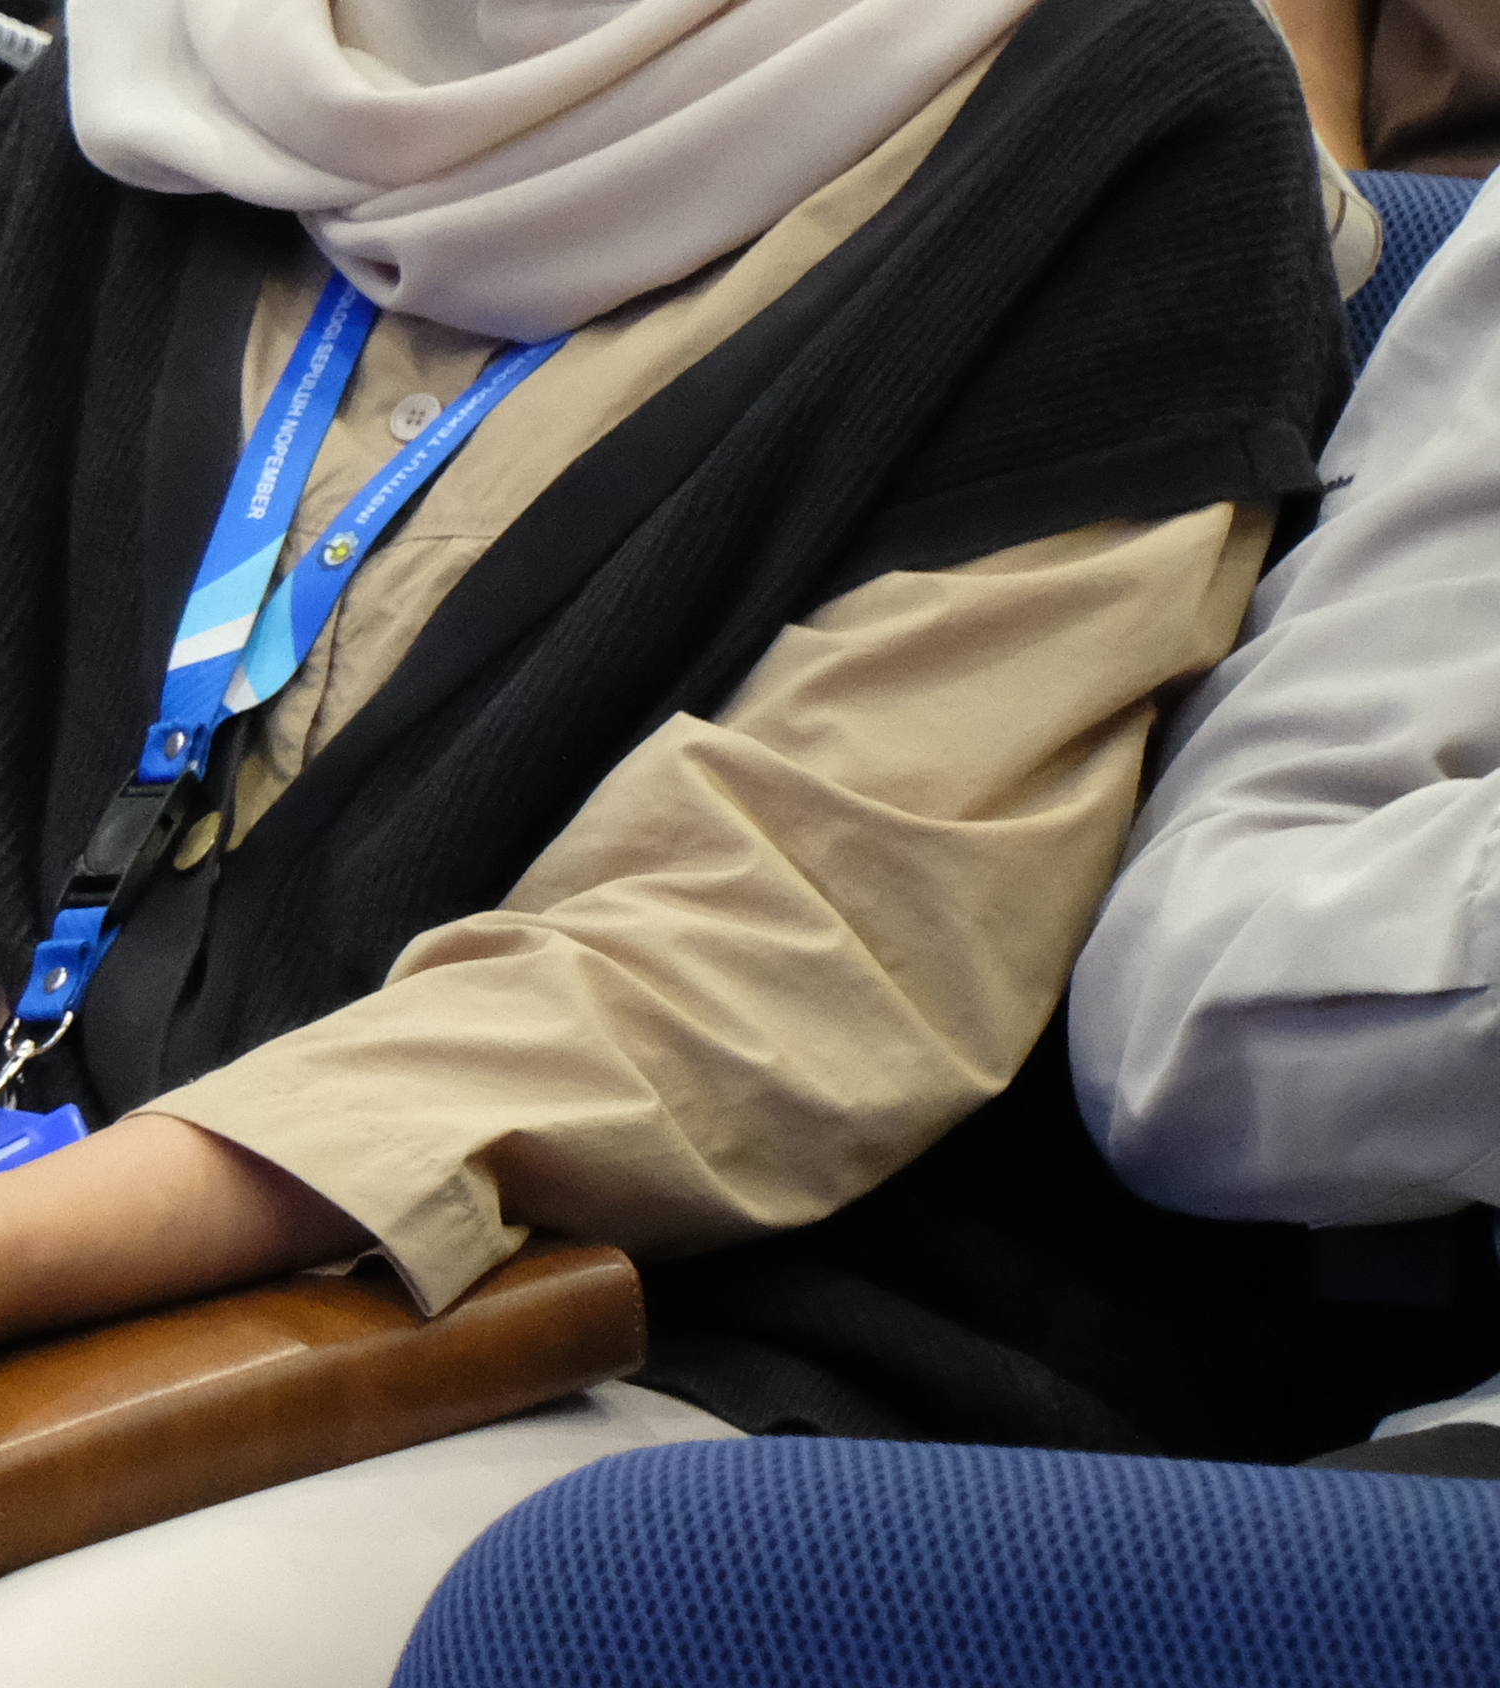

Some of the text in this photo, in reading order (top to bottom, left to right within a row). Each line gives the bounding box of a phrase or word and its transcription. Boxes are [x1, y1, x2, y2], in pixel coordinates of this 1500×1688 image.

[287, 342, 335, 417] SEPULUH
[246, 418, 299, 520] NOPEMBER
[354, 449, 428, 525] INSTITUT
